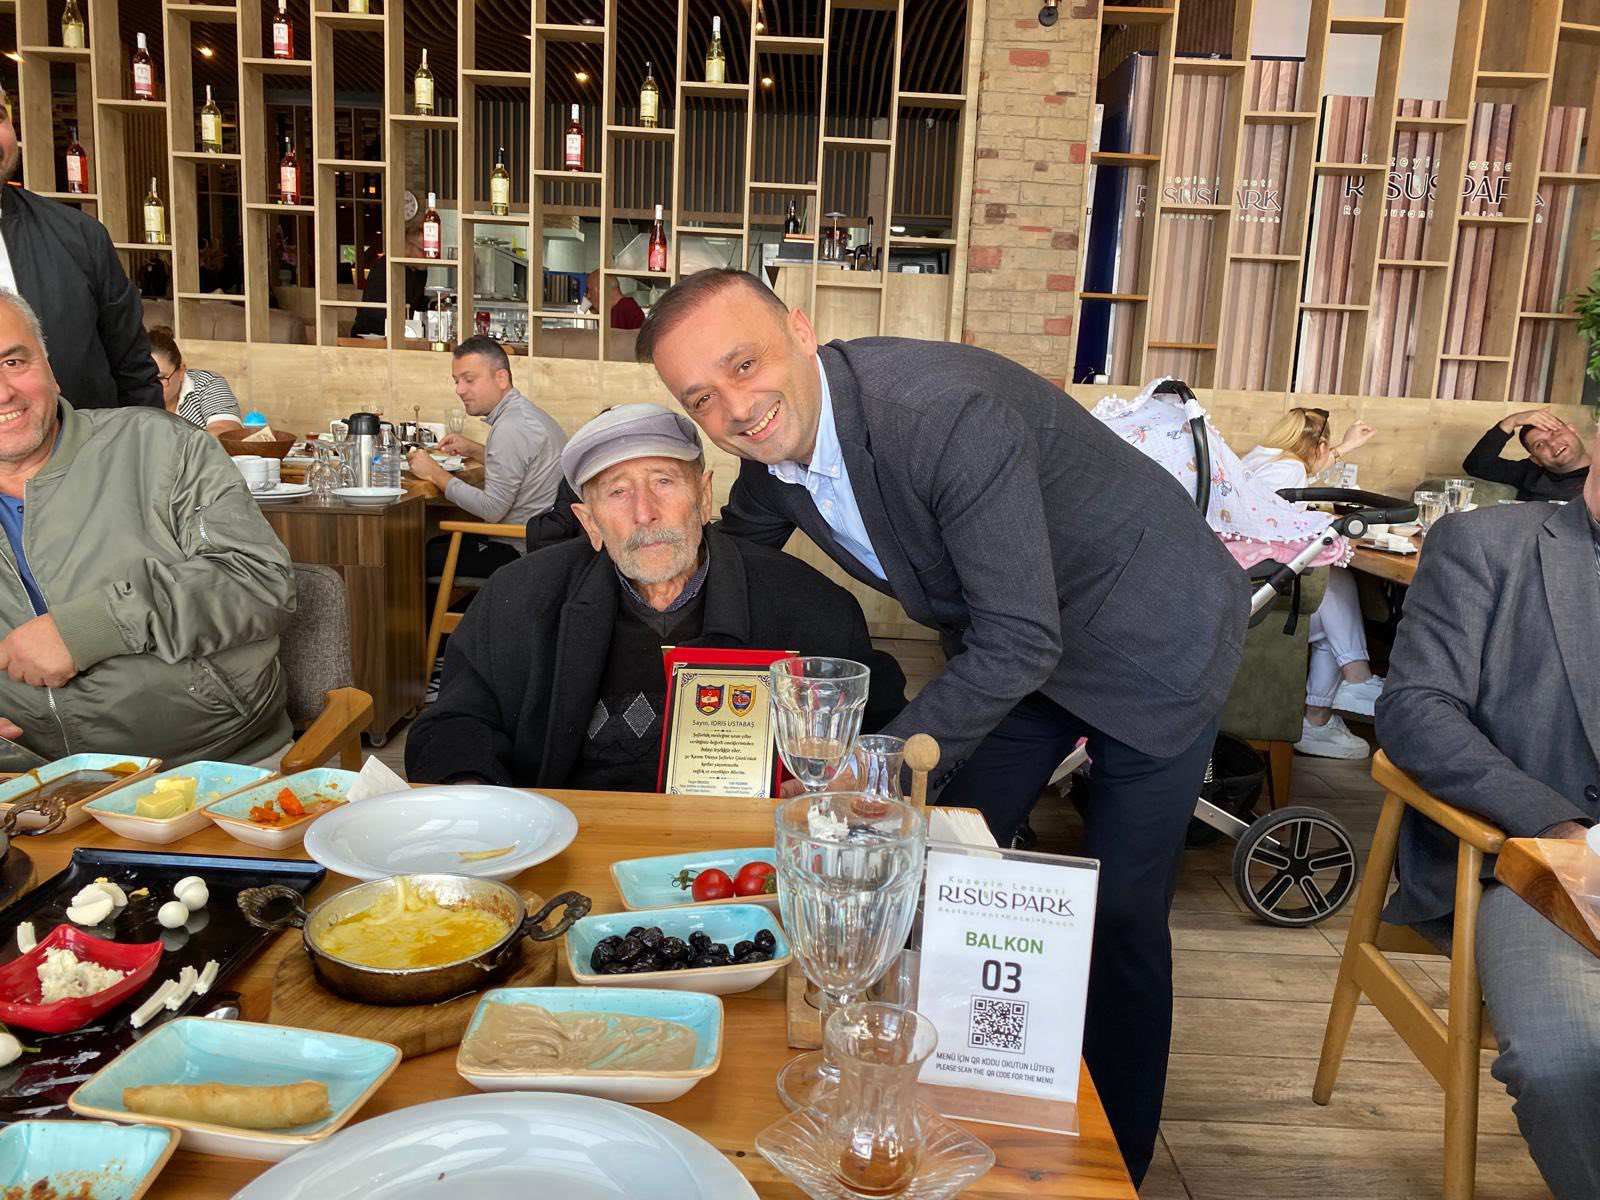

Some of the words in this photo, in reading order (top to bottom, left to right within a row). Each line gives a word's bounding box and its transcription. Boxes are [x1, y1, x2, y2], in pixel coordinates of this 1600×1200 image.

[1345, 172, 1439, 201] RSUS
[966, 930, 1044, 954] BALKON
[982, 959, 1022, 994] 03
[936, 1052, 955, 1061] MENÜ
[971, 1056, 981, 1065] QR
[1001, 1060, 1028, 1070] OKUTUN
[1030, 1062, 1055, 1073] LÜTFEN
[936, 1063, 956, 1072] PLEASE
[958, 1066, 972, 1074] SCAN
[974, 1068, 984, 1076] THE
[986, 1070, 995, 1078] QR
[996, 1071, 1010, 1079] CODE
[1036, 1076, 1053, 1084] MENU
